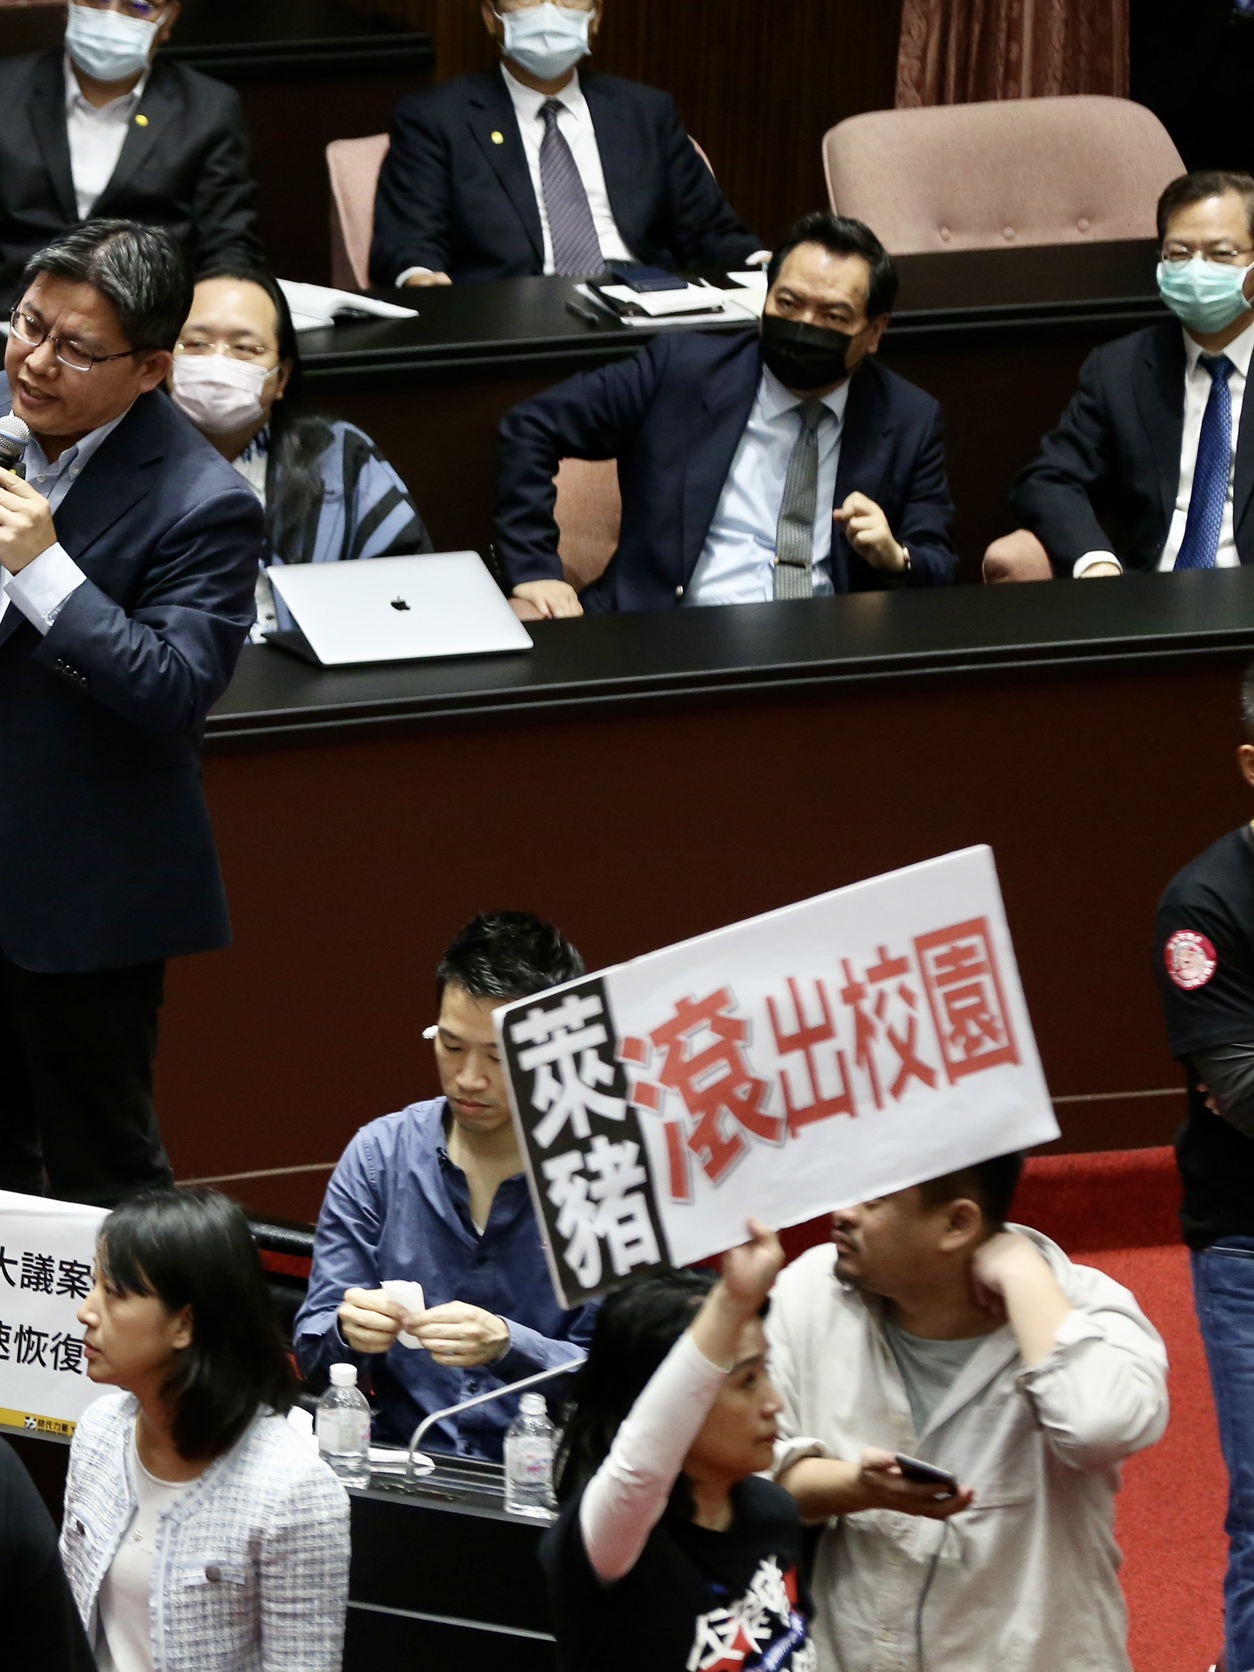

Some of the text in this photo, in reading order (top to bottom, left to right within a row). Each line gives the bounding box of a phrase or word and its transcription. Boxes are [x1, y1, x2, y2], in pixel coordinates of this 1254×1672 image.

[510, 995, 662, 1288] 萊豬
[616, 915, 1022, 1204] 滾出校園
